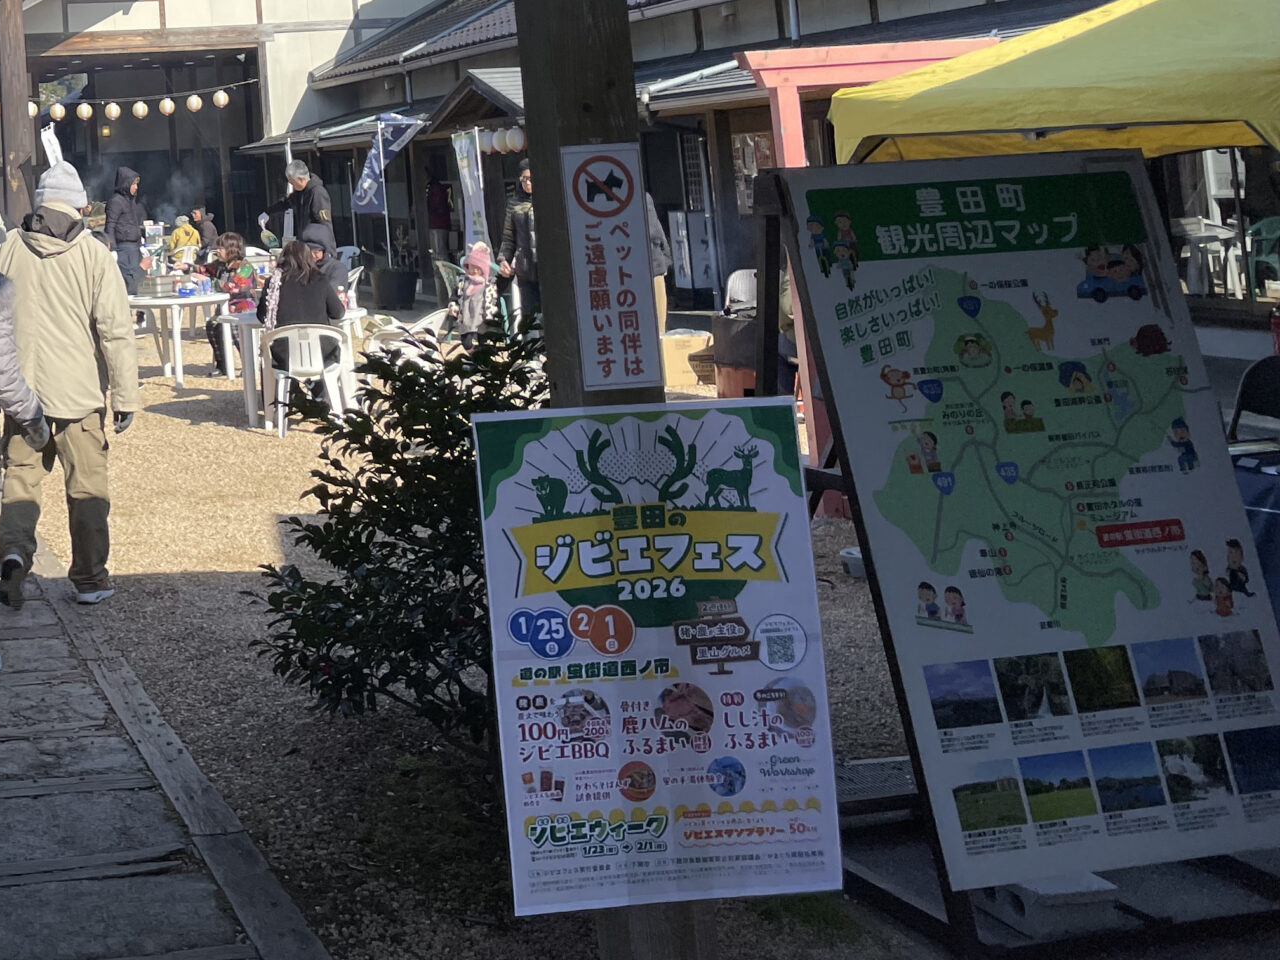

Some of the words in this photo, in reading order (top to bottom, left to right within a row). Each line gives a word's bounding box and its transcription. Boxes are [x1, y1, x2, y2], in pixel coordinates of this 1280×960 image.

[915, 183, 1027, 217] 豊田町
[876, 212, 1079, 256] 観光周辺マップ
[585, 221, 617, 379] ご遠慮願います
[609, 221, 644, 377] ペットの同伴は
[835, 268, 935, 321] 自然がいっぱい!
[860, 330, 912, 364] 豊田町
[612, 503, 686, 531] 豊田の
[534, 531, 765, 583] ジビエフェス
[617, 579, 686, 600] 2026
[697, 645, 751, 659] 里山グルメ
[620, 701, 649, 712] 骨付き
[622, 715, 687, 735] 鹿ハムの
[724, 709, 783, 728] しし汁の
[518, 721, 569, 742] 100円
[725, 732, 788, 750] ふるまい
[519, 742, 610, 762] ジビエBBQ
[623, 737, 686, 754] ふるまい
[760, 767, 815, 776] Workshop
[770, 755, 800, 767] Green
[530, 816, 666, 846] ジビエウィーク
